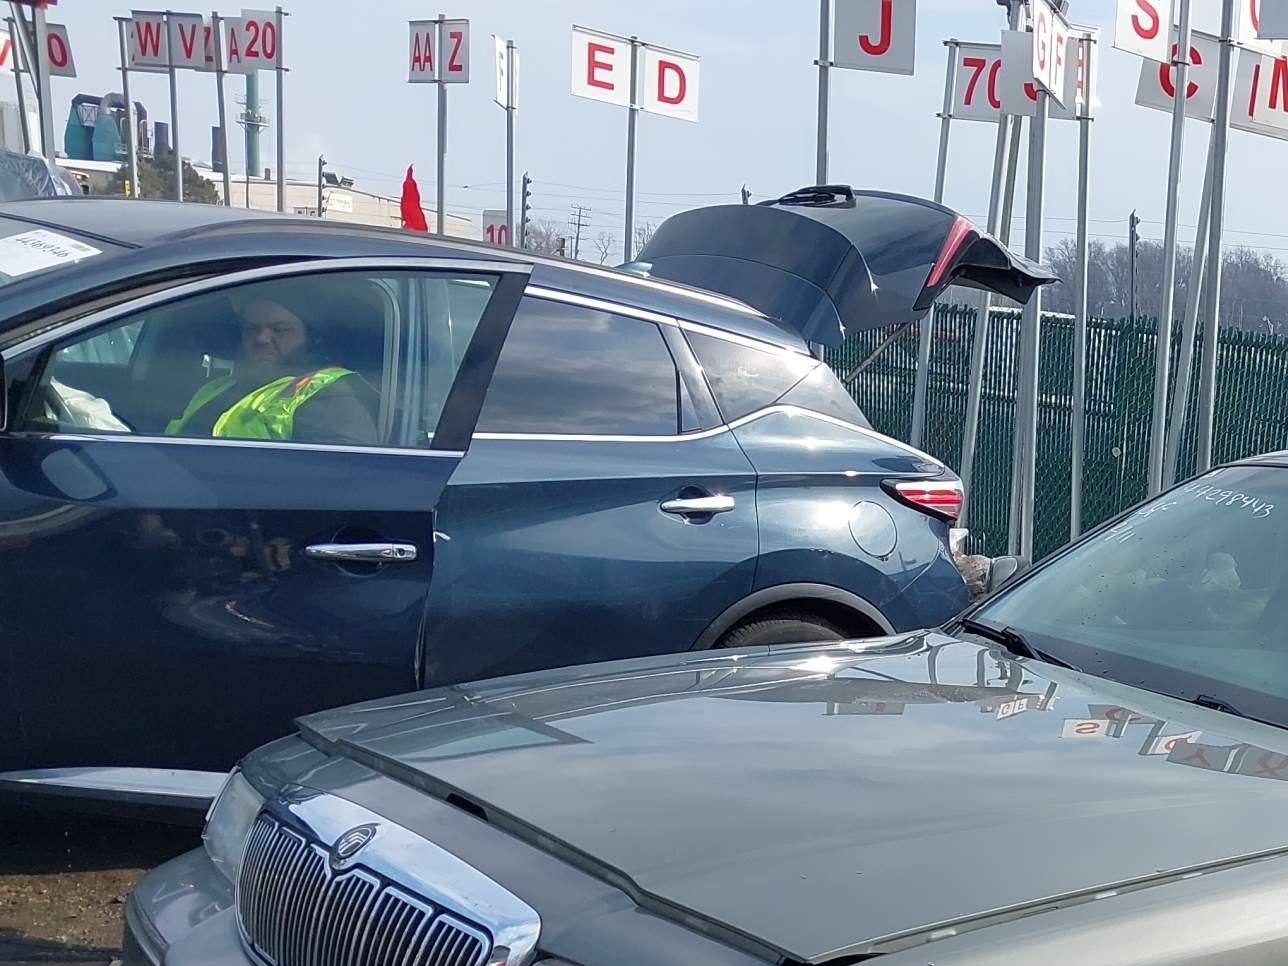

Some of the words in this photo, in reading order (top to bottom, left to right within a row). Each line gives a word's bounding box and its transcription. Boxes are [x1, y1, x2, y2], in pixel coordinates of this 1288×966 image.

[135, 21, 161, 58] W
[177, 23, 197, 60] V
[244, 20, 276, 60] 20
[411, 32, 434, 72] AA
[448, 31, 463, 72] Z
[587, 42, 615, 91] E
[656, 59, 687, 105] D
[1159, 43, 1203, 98] C
